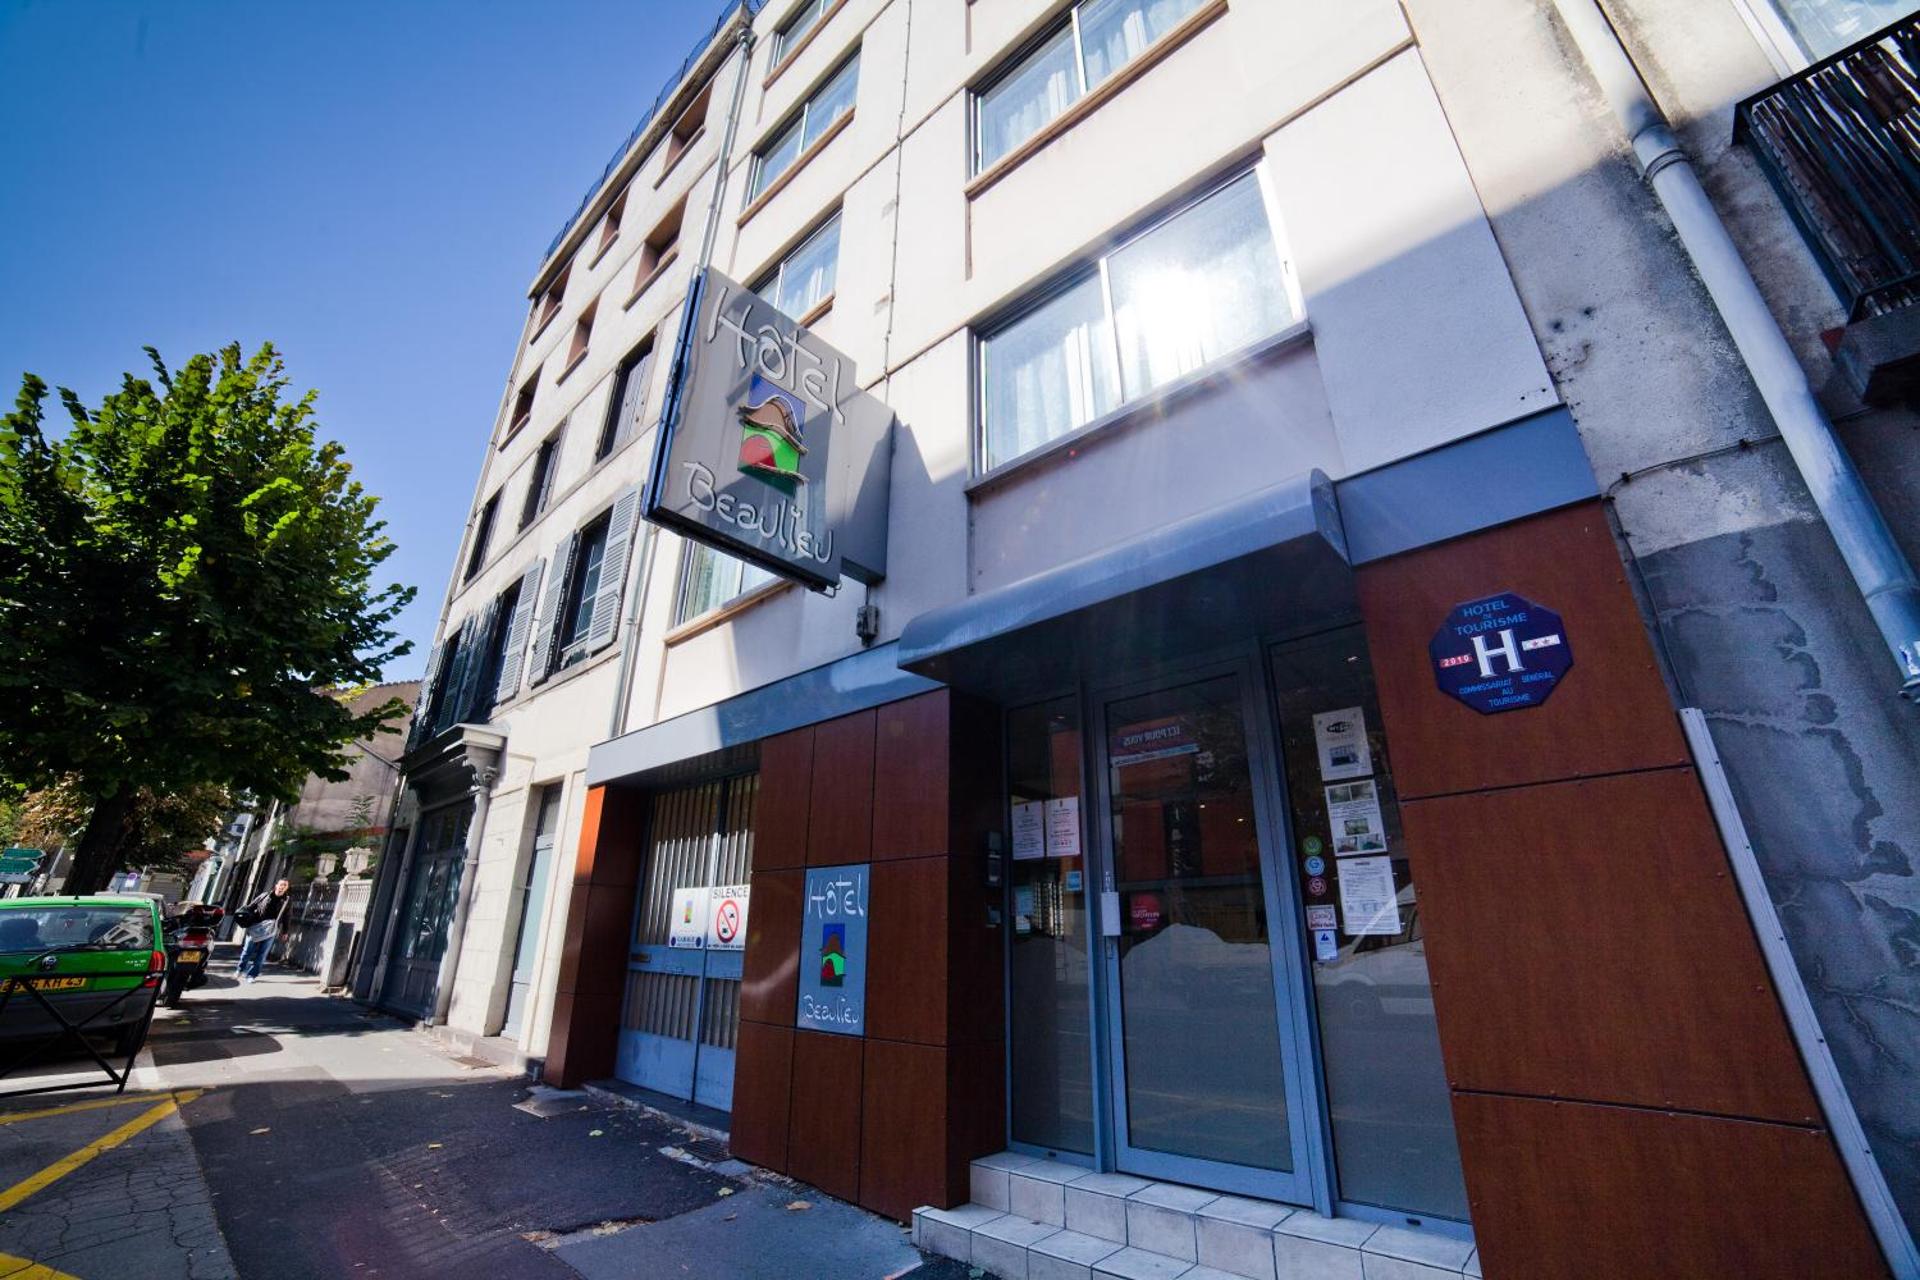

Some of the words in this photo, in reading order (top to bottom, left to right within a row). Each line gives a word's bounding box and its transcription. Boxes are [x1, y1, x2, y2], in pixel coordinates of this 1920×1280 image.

[683, 460, 835, 564] Beaulieu
[1463, 600, 1510, 617] HOTEL
[1455, 612, 1527, 636] TOURISME
[1470, 628, 1528, 678] H
[1488, 694, 1530, 707] TOURISME
[1502, 687, 1514, 695] AU
[713, 886, 748, 900] SILENCE
[803, 994, 860, 1025] Beaulieu
